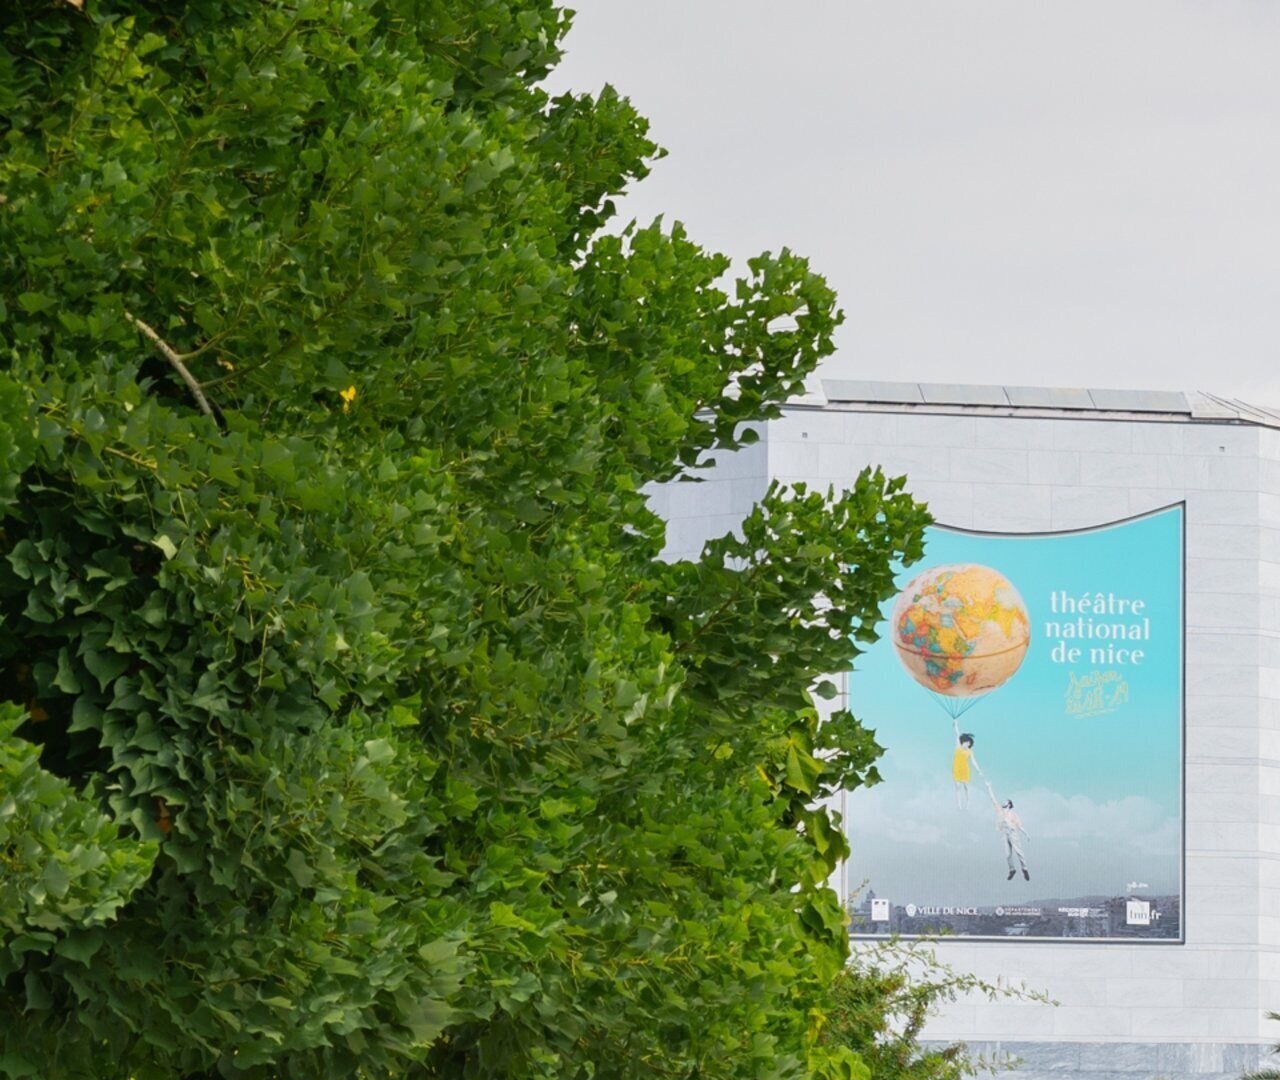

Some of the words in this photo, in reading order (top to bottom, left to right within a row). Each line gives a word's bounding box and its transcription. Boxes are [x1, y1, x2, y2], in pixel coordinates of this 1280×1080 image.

[1051, 590, 1145, 616] théâtre
[1045, 617, 1150, 640] national
[1051, 640, 1081, 664] de
[1090, 643, 1145, 665] nice
[918, 906, 941, 915] VILLE
[943, 907, 955, 915] DE
[956, 907, 978, 916] NICE
